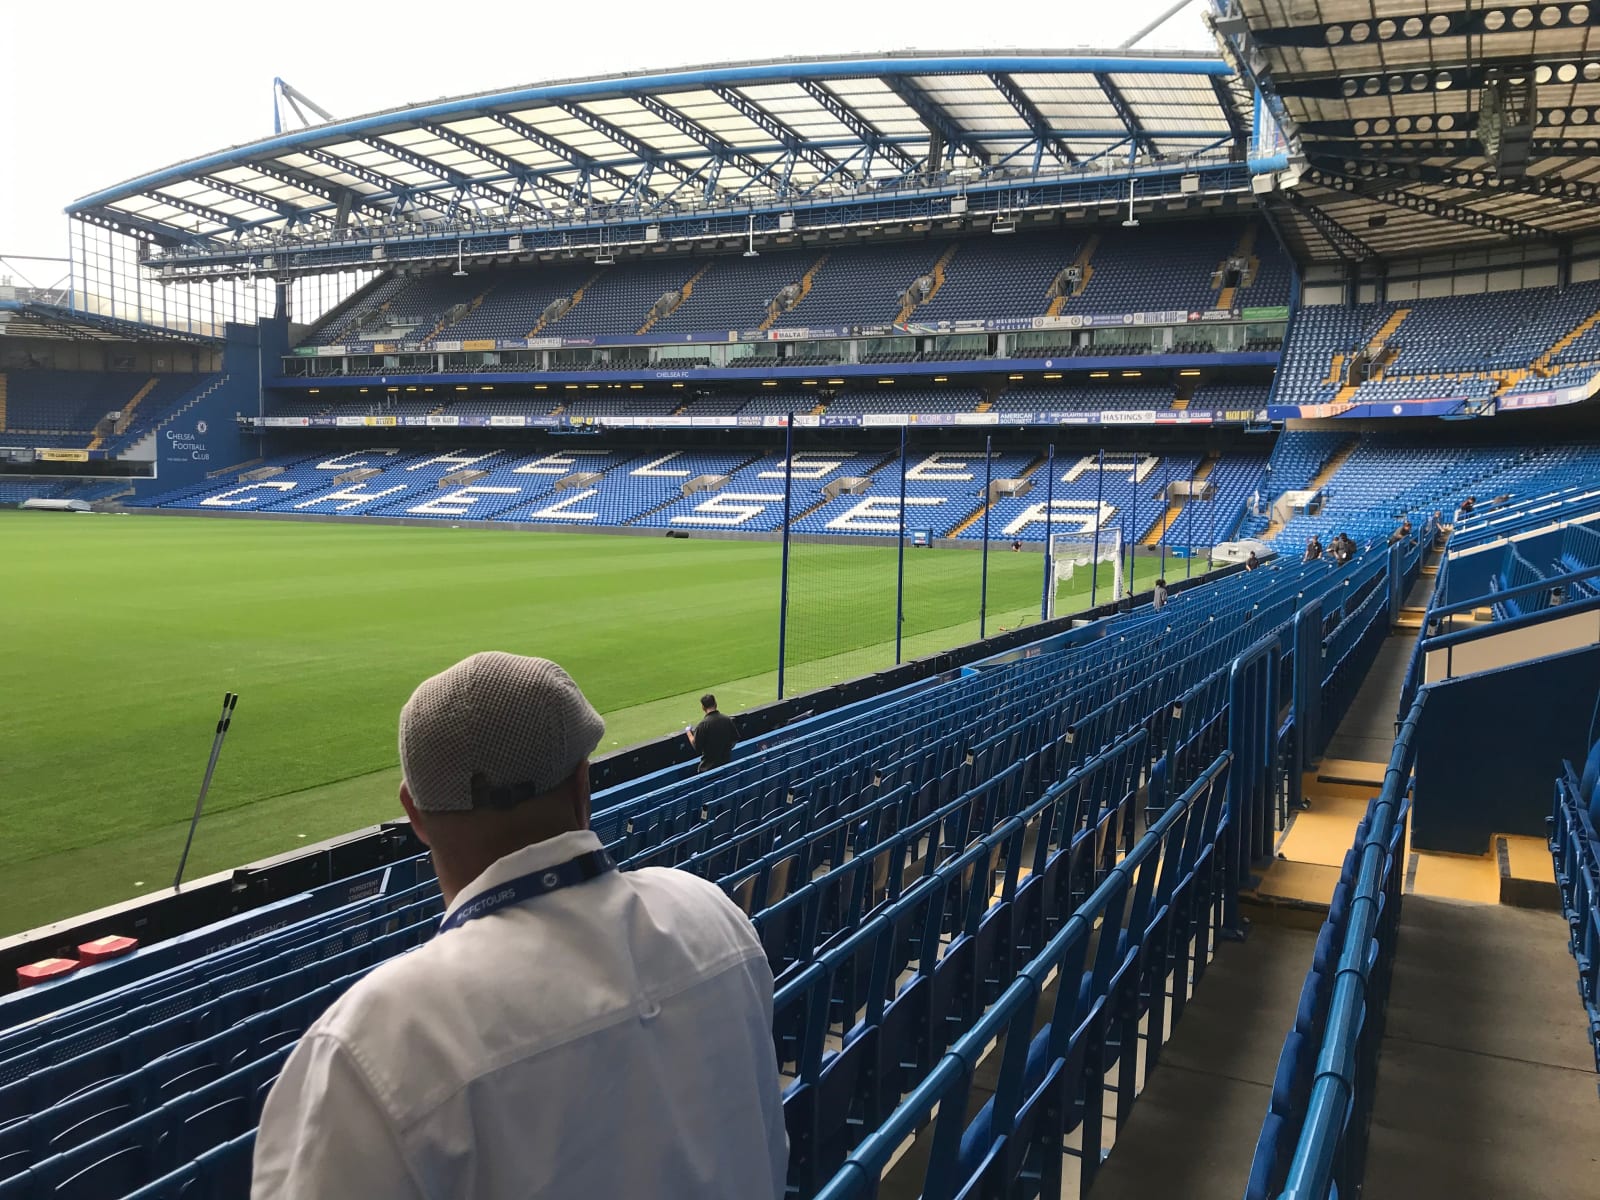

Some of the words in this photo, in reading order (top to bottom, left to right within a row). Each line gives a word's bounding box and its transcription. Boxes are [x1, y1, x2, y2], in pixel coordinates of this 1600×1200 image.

[920, 415, 941, 423] CORK
[1103, 413, 1142, 422] HASTINGS
[166, 430, 195, 441] CHELSEA
[172, 440, 207, 451] FOOTBALL
[191, 450, 210, 460] CLUB
[314, 446, 1159, 483] CHELSEA
[200, 480, 1118, 536] CHELSEA
